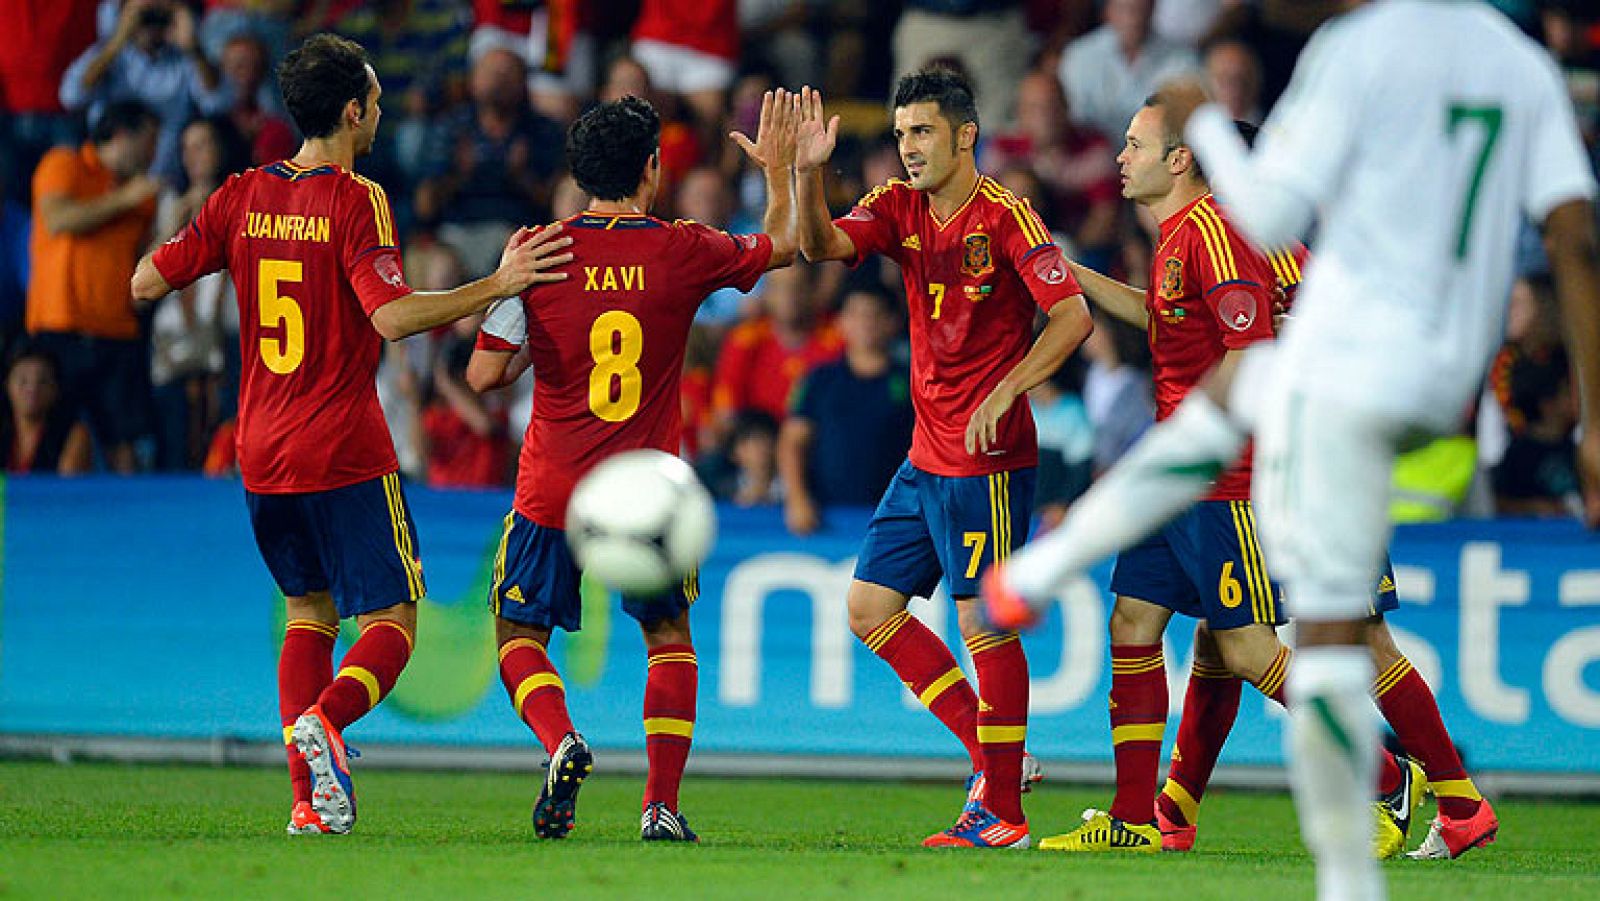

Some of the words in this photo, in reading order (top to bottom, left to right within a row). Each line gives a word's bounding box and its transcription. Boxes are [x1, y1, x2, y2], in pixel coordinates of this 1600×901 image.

[1446, 106, 1504, 261] 7
[241, 211, 330, 243] UANFRAN
[583, 264, 646, 292] XAVI
[928, 282, 946, 320] 7
[258, 258, 305, 375] 5
[588, 309, 644, 423] 8
[962, 531, 987, 580] 7
[1218, 560, 1243, 609] 6
